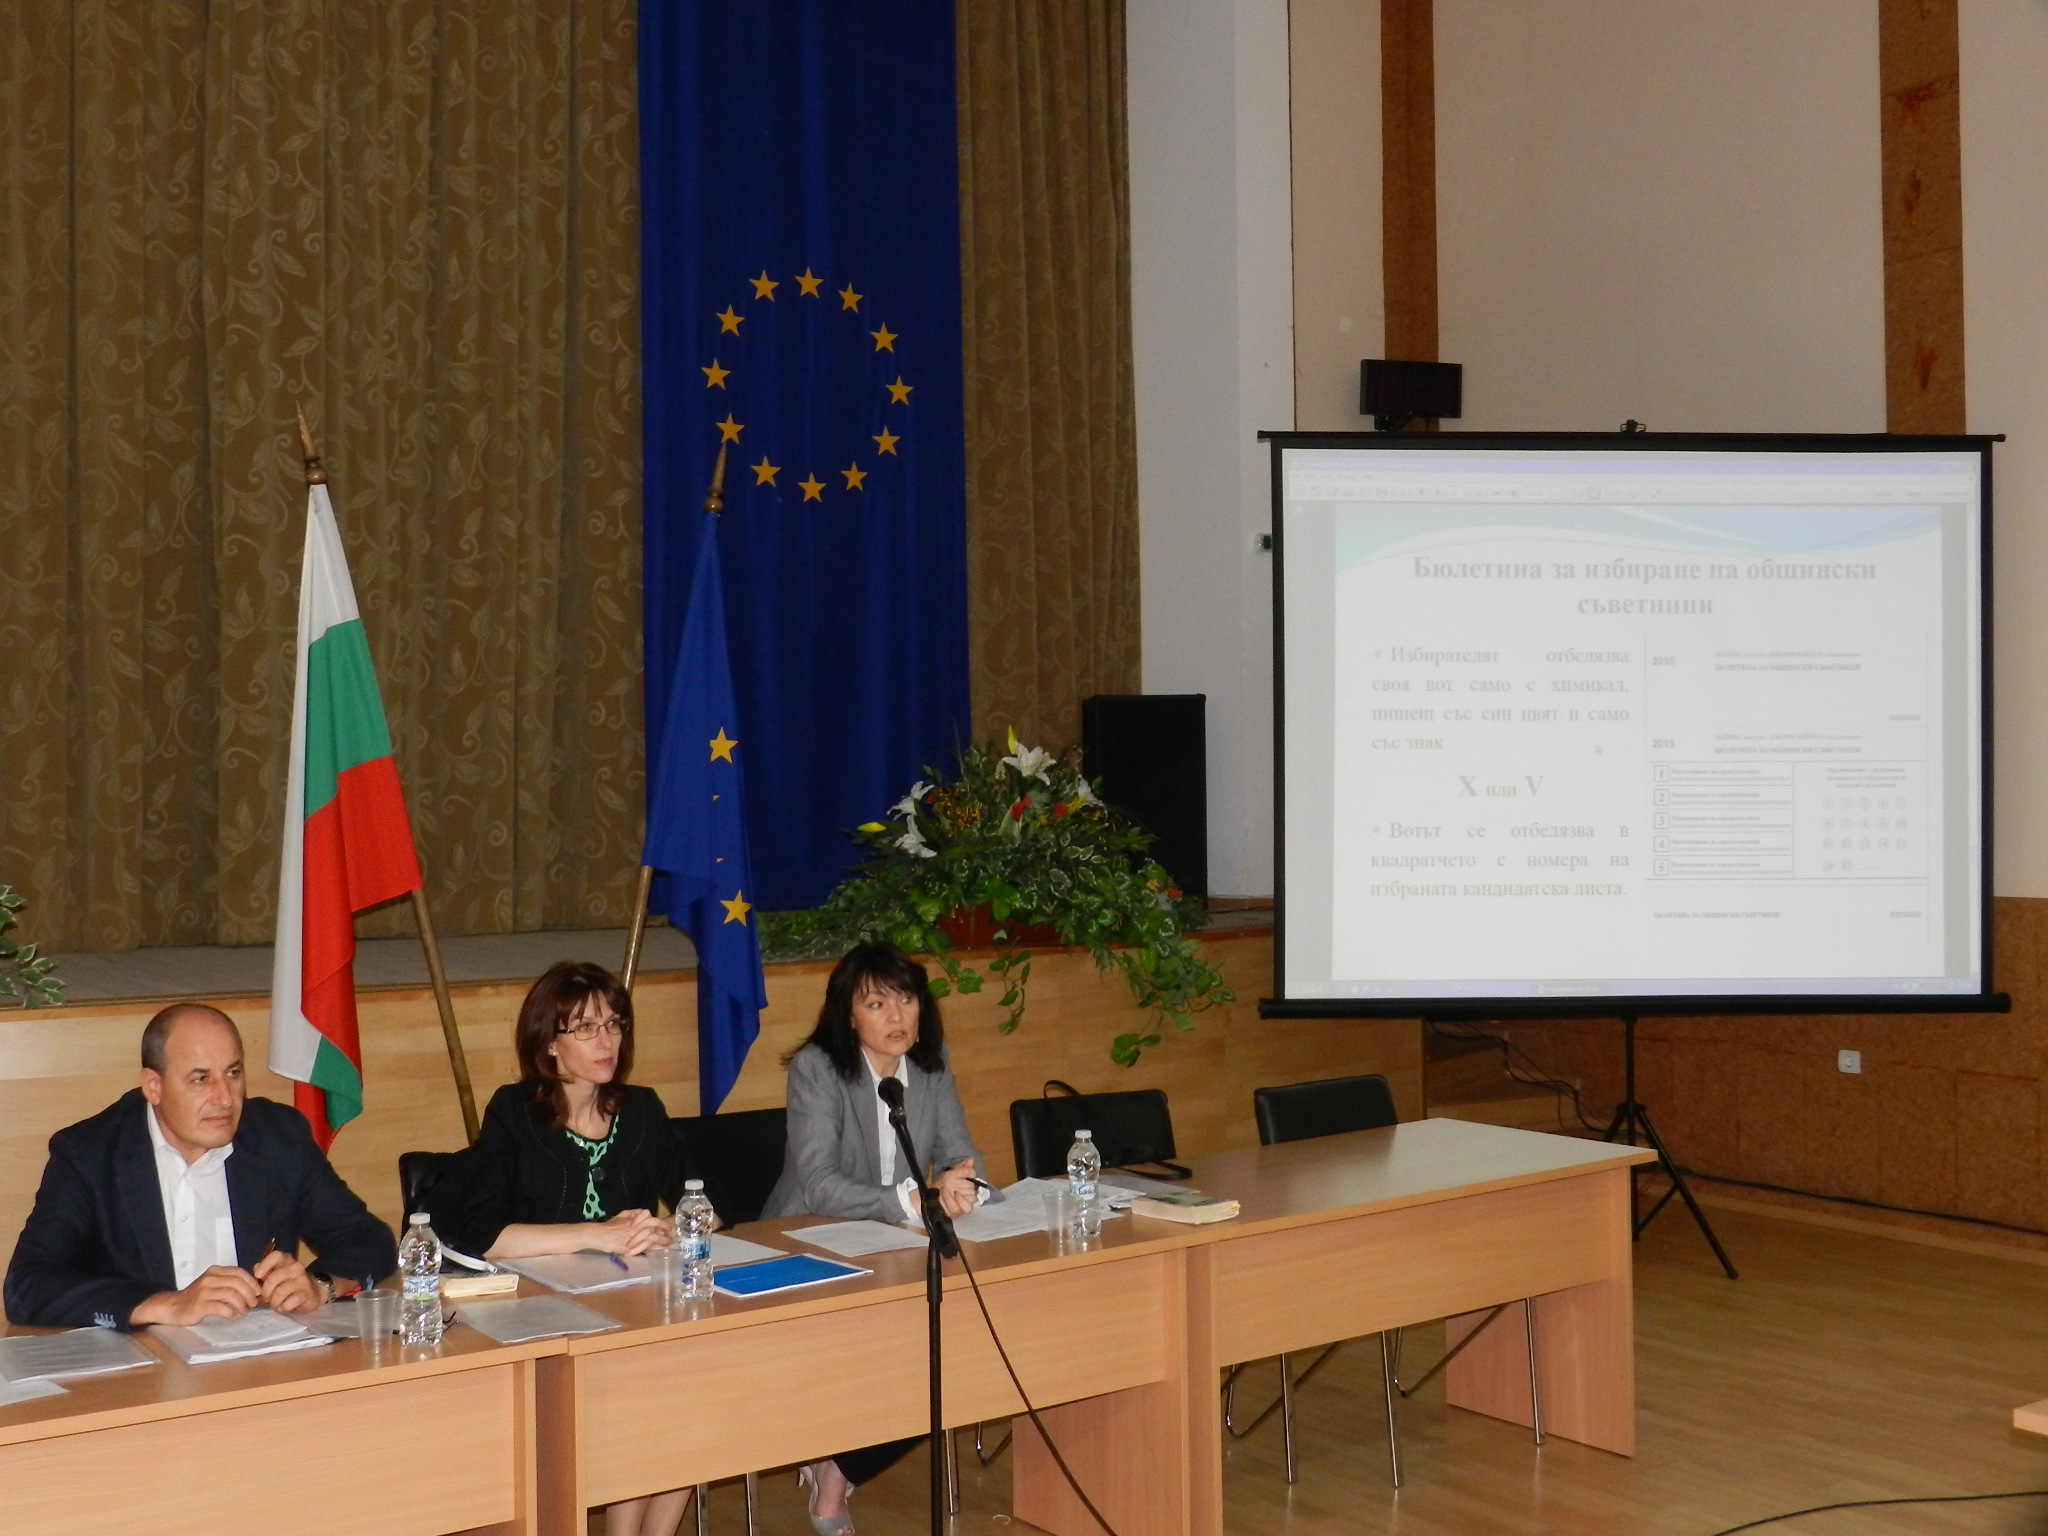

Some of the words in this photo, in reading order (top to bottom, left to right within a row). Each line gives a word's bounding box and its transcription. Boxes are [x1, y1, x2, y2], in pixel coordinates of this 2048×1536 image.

[1413, 556, 1543, 579] Бюлетина
[1553, 563, 1575, 579] за
[1584, 558, 1701, 584] избиране
[1709, 563, 1738, 579] на
[1746, 559, 1876, 581] общински
[1577, 598, 1714, 616] съветници
[1391, 646, 1500, 666] Избирателят
[1546, 648, 1630, 663] отбелязва
[1652, 656, 1675, 666] 2015
[1371, 680, 1411, 692] своя
[1425, 680, 1455, 692] вот
[1469, 680, 1511, 692] само
[1526, 680, 1536, 692] с
[1443, 708, 1472, 721] със
[1481, 708, 1512, 721] син
[1521, 708, 1559, 722] цвят
[1568, 708, 1580, 721] и
[1588, 708, 1630, 721] само
[1371, 738, 1401, 750] със
[1405, 738, 1444, 750] знак
[1652, 739, 1675, 748] 2015
[1486, 785, 1517, 797] или
[1524, 775, 1544, 797] V
[1389, 823, 1442, 838] Вотът
[1467, 826, 1486, 838] се
[1510, 823, 1595, 838] отбелязва
[1619, 826, 1629, 838] в
[1371, 855, 1476, 871] квадратчето
[1496, 855, 1506, 867] с
[1527, 855, 1589, 871] номера
[1610, 855, 1630, 867] на
[1371, 880, 1457, 900] избраната
[1463, 883, 1569, 897] кандидатска
